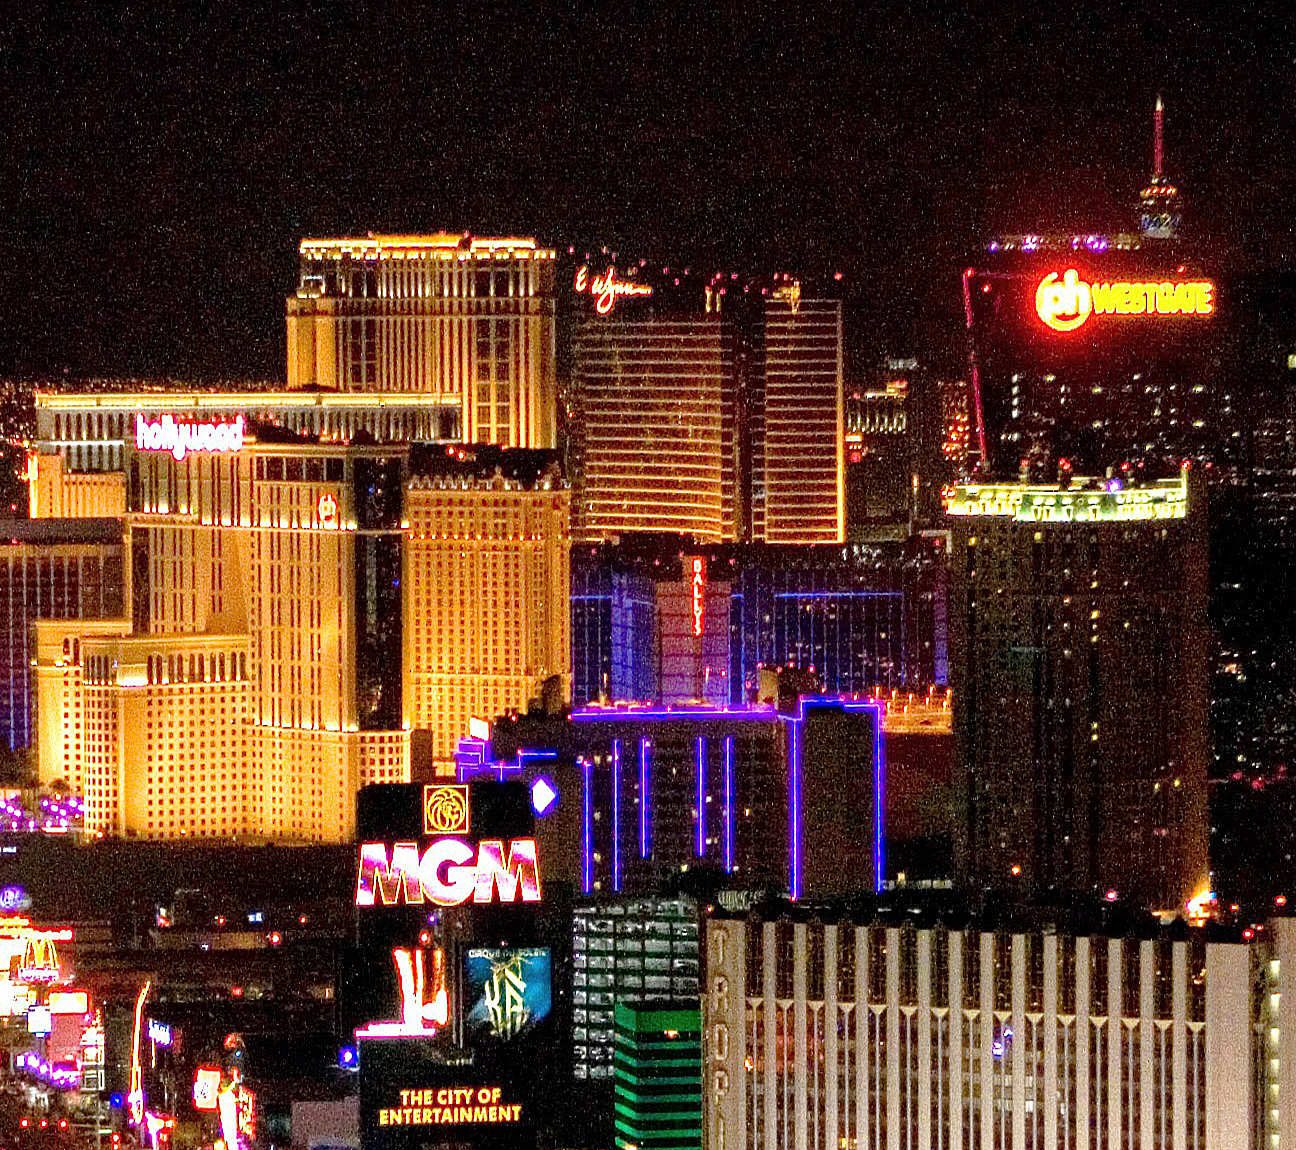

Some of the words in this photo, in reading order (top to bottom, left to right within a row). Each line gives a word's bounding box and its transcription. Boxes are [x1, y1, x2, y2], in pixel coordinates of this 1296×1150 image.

[1092, 283, 1213, 314] WESTGATE
[137, 414, 244, 460] hollywood
[356, 838, 542, 907] MGM
[400, 1089, 433, 1106] THE
[437, 1088, 474, 1105] CITY
[477, 1087, 502, 1104] OF
[379, 1105, 522, 1126] ENTERTAINMENT
